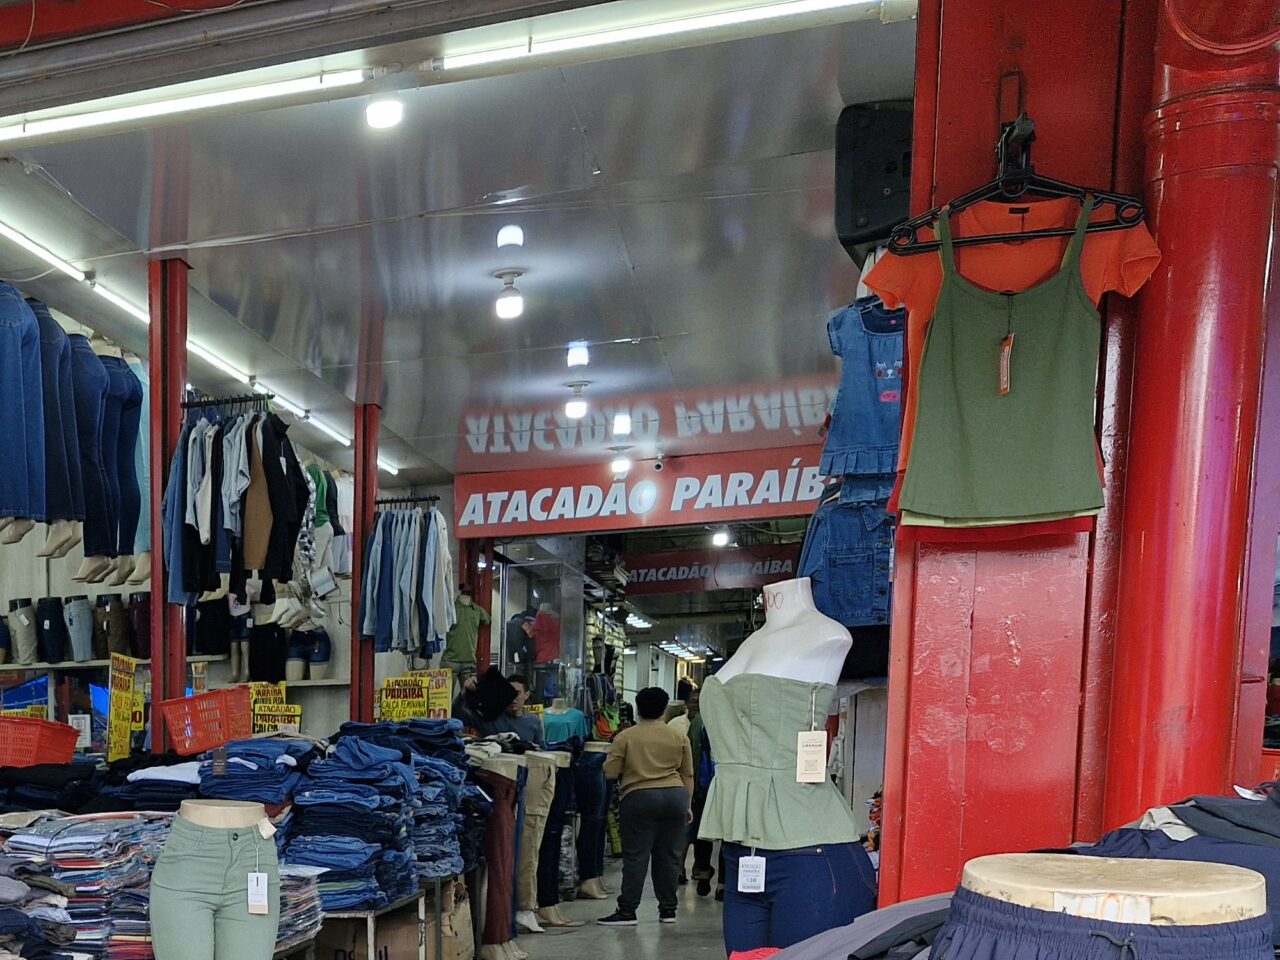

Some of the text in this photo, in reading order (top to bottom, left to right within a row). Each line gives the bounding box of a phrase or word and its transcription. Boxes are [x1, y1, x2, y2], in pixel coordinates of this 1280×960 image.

[458, 458, 826, 527] ATACADÃO PARAÍB
[628, 562, 711, 583] ATACADÃO
